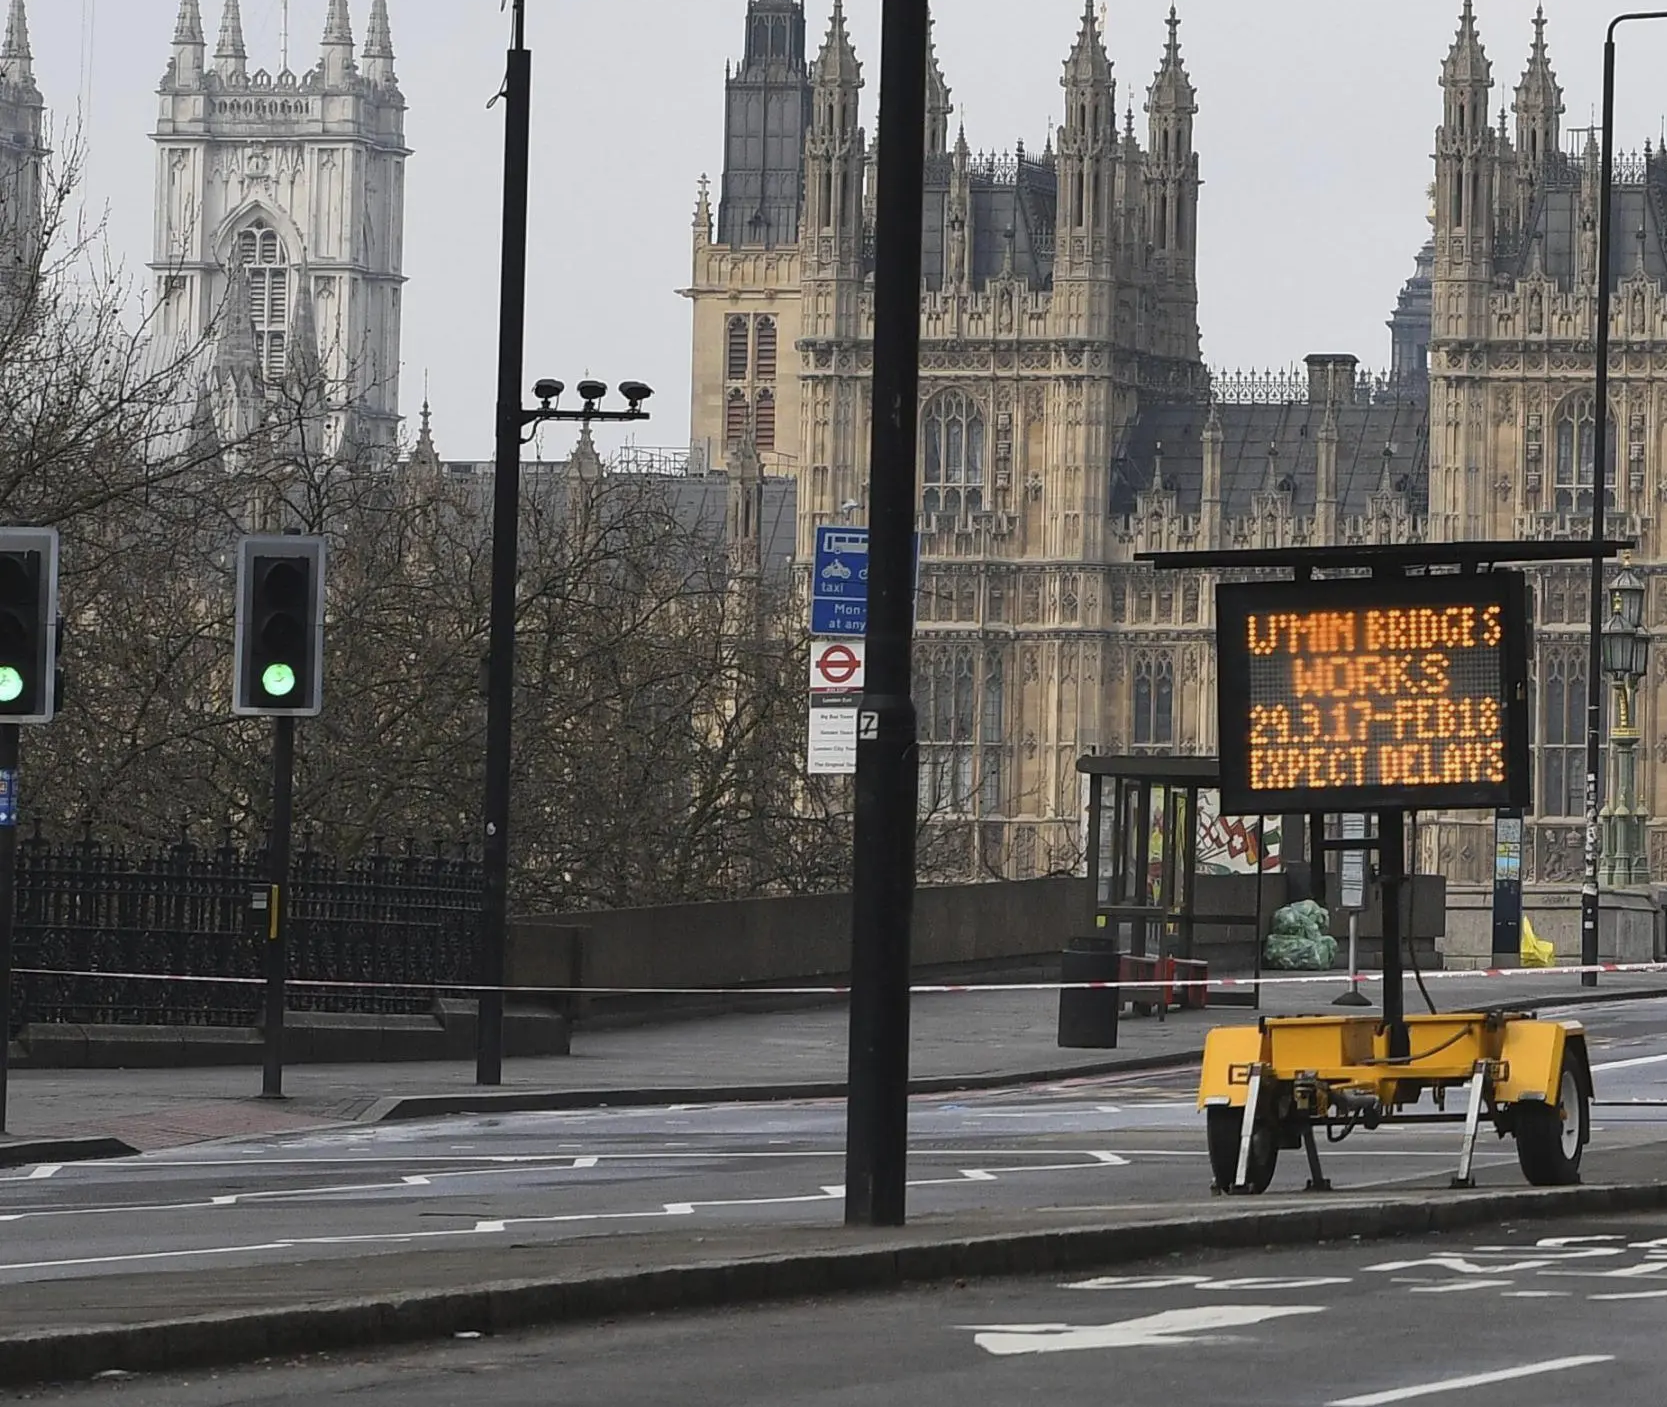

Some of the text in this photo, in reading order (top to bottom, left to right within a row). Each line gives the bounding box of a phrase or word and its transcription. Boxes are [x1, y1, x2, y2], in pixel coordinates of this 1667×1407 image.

[821, 582, 844, 593] taxi
[828, 618, 867, 634] at any
[1363, 606, 1503, 652] BRIDGES
[1293, 653, 1451, 698] WORKS
[1249, 740, 1507, 791] EXPECT DELAYS
